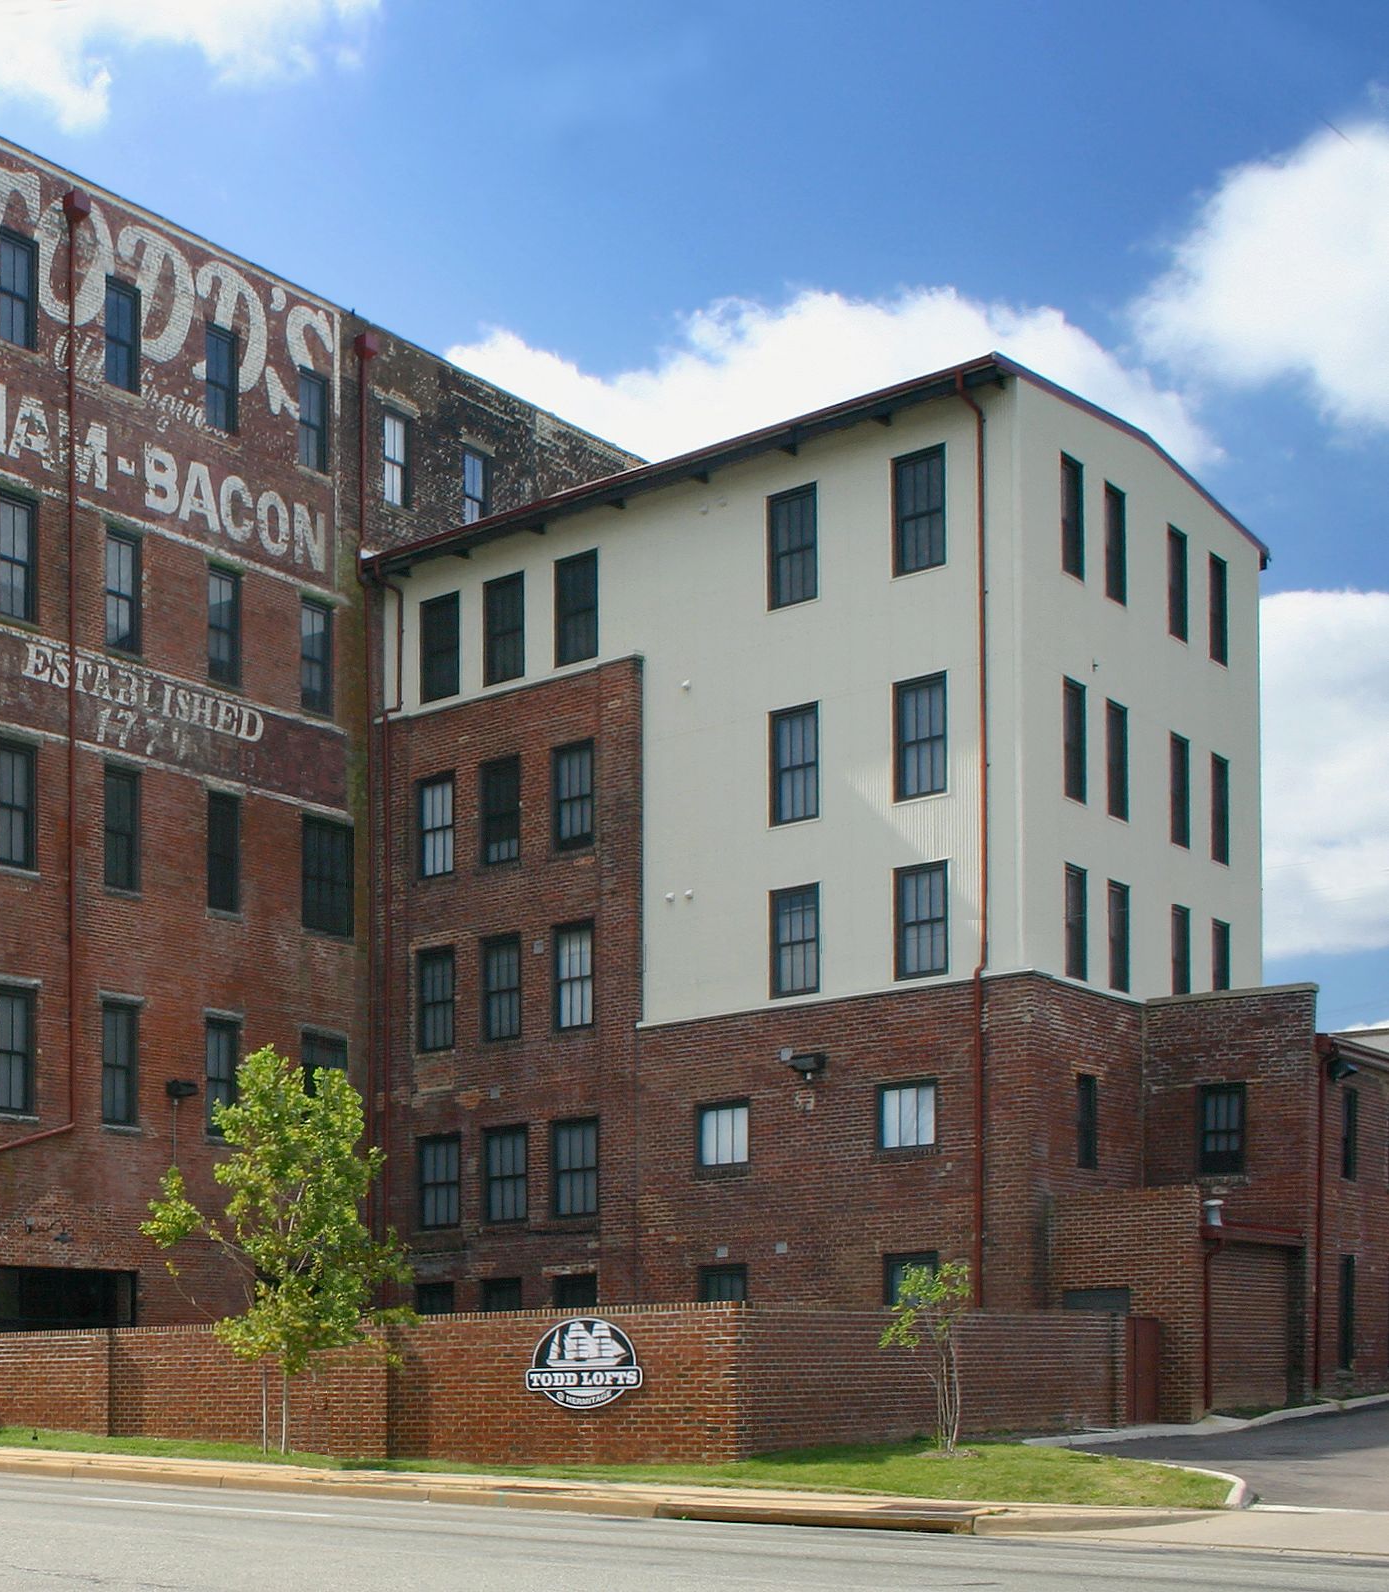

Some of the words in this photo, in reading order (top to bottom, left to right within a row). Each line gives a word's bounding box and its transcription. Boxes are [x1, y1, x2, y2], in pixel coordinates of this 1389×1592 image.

[22, 643, 264, 742] ESTABLISHED
[530, 1373, 578, 1386] TODD
[581, 1371, 638, 1385] LOFTS
